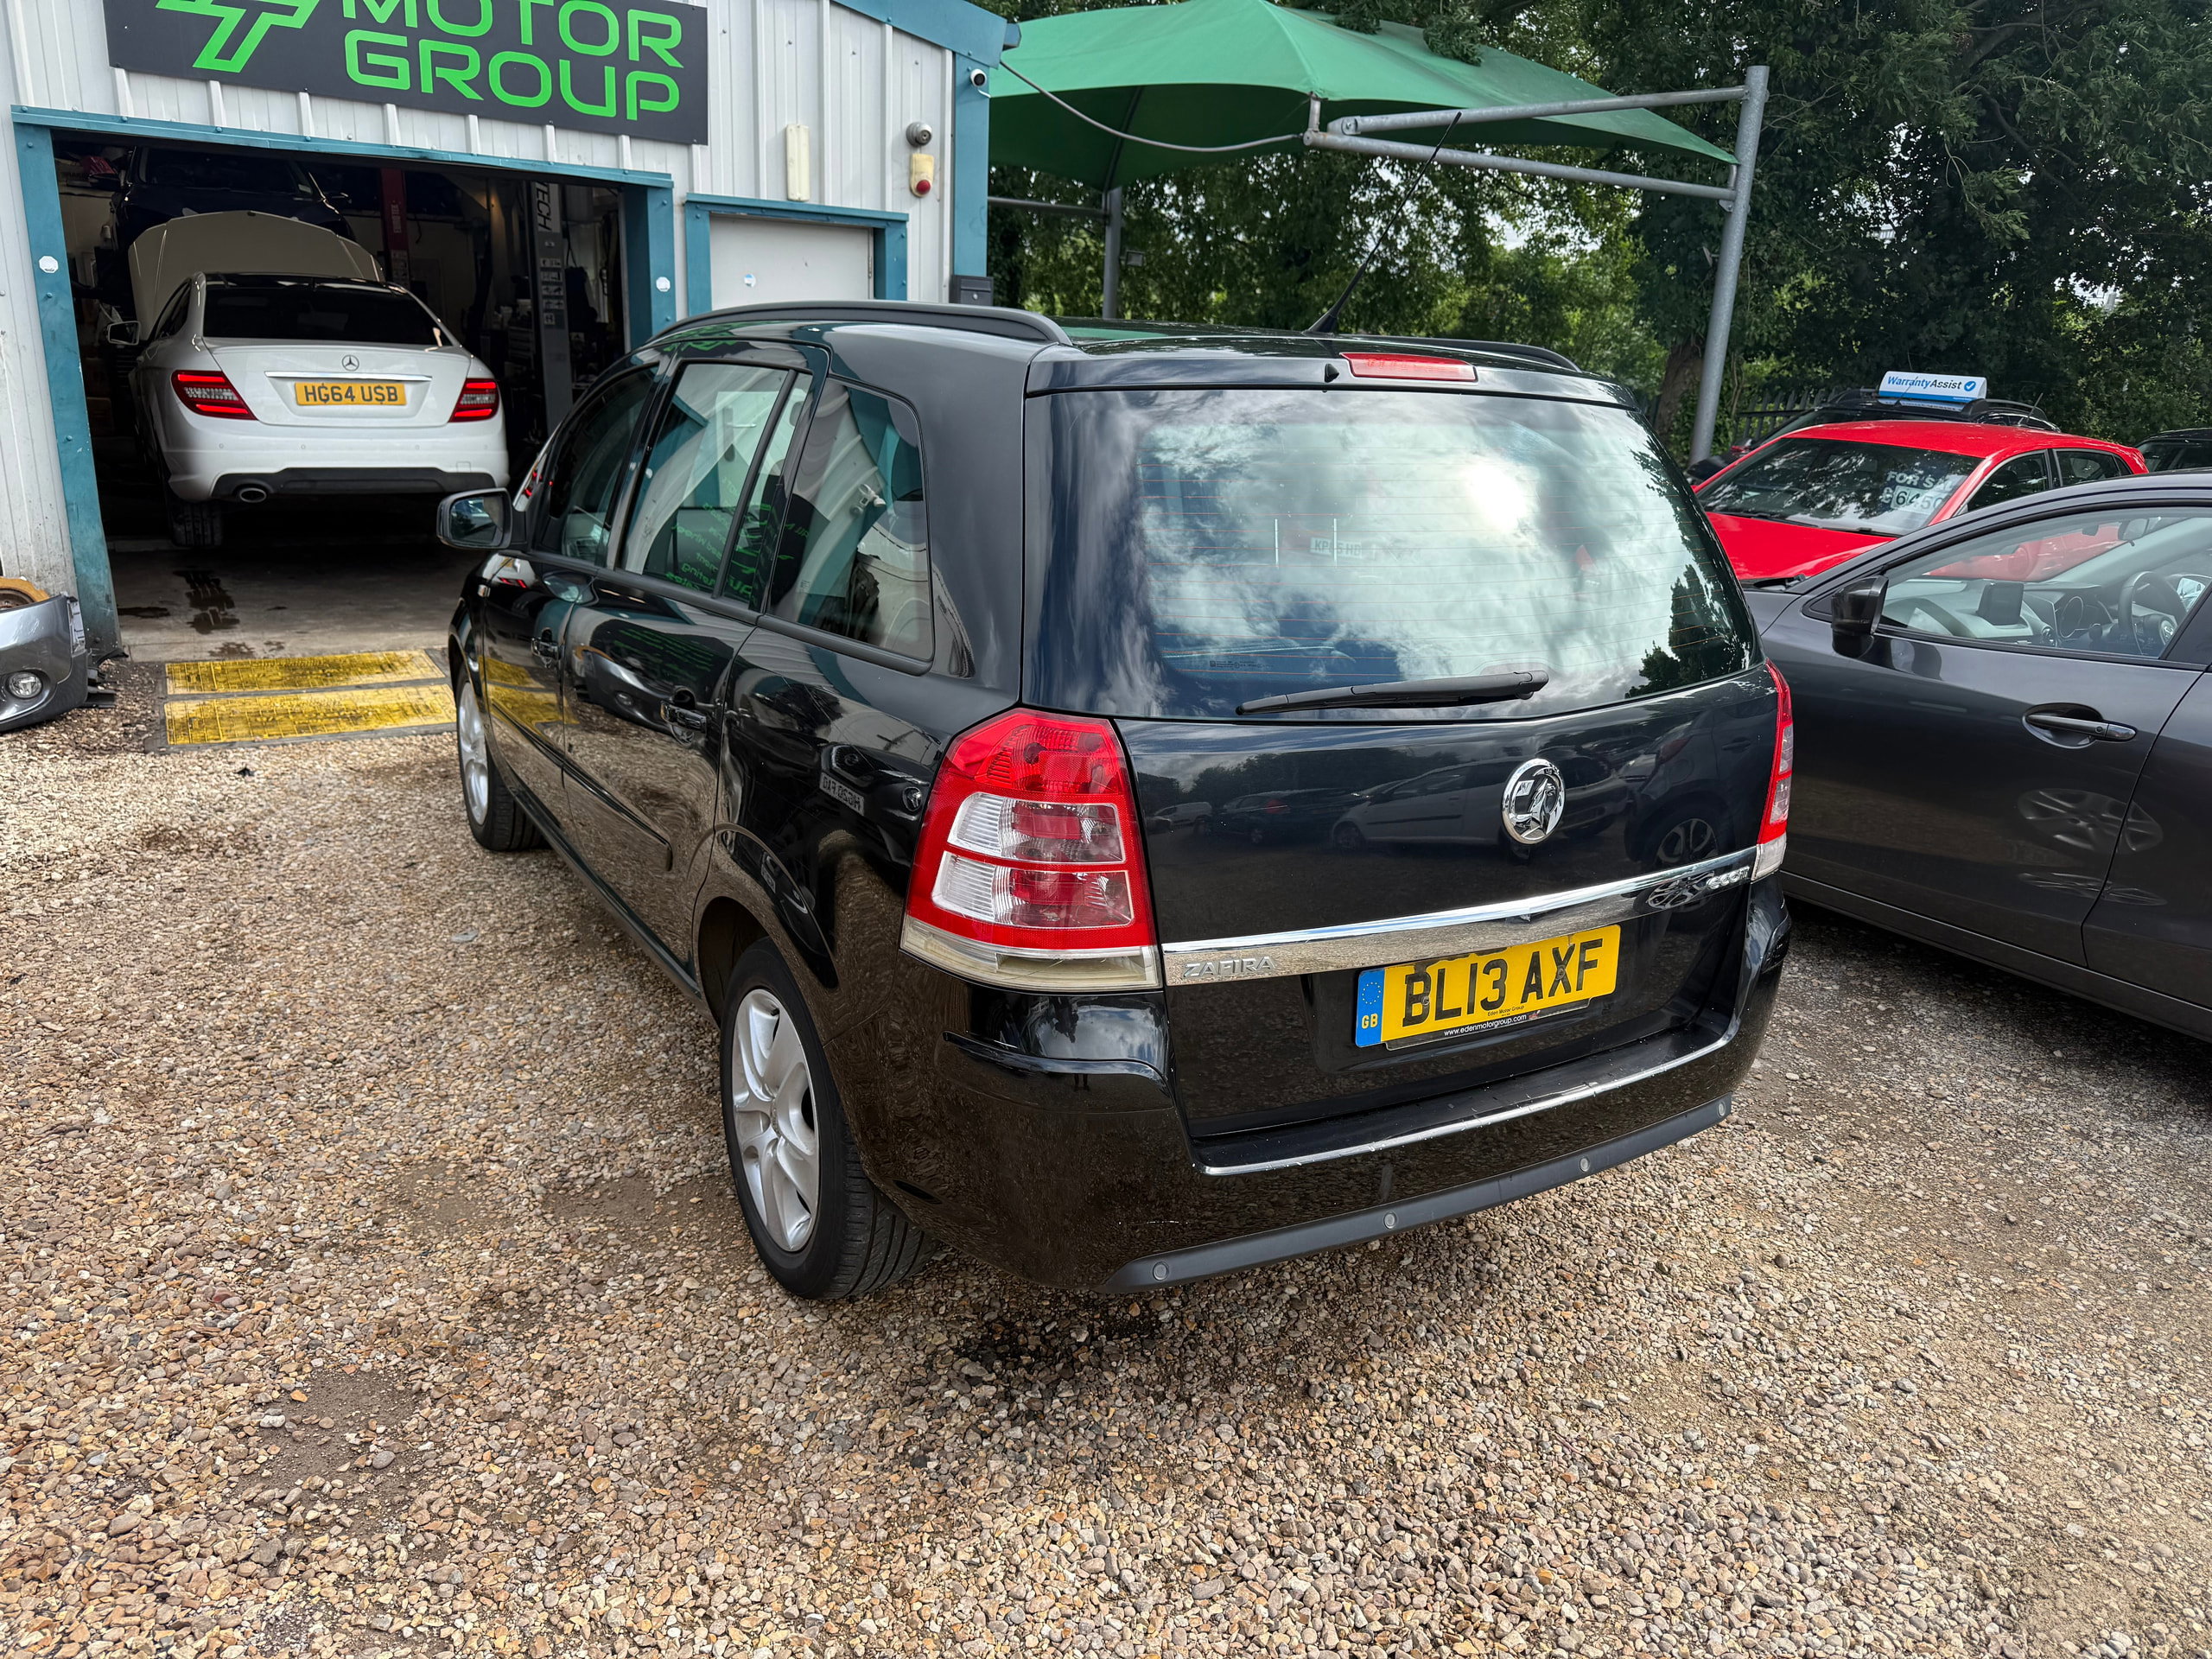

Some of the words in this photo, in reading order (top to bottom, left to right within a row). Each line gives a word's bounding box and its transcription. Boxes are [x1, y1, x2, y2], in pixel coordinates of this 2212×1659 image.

[345, 29, 680, 121] GROUP
[304, 385, 355, 402] HG64
[360, 385, 398, 402] USB
[1886, 471, 1919, 486] FOR
[1183, 956, 1275, 977] ZAFIRA
[1402, 958, 1508, 1027] BL13
[1521, 938, 1603, 1004] AXF
[1361, 1013, 1378, 1029] GB
[1444, 1014, 1527, 1036] www.edenmotorgroup.com
